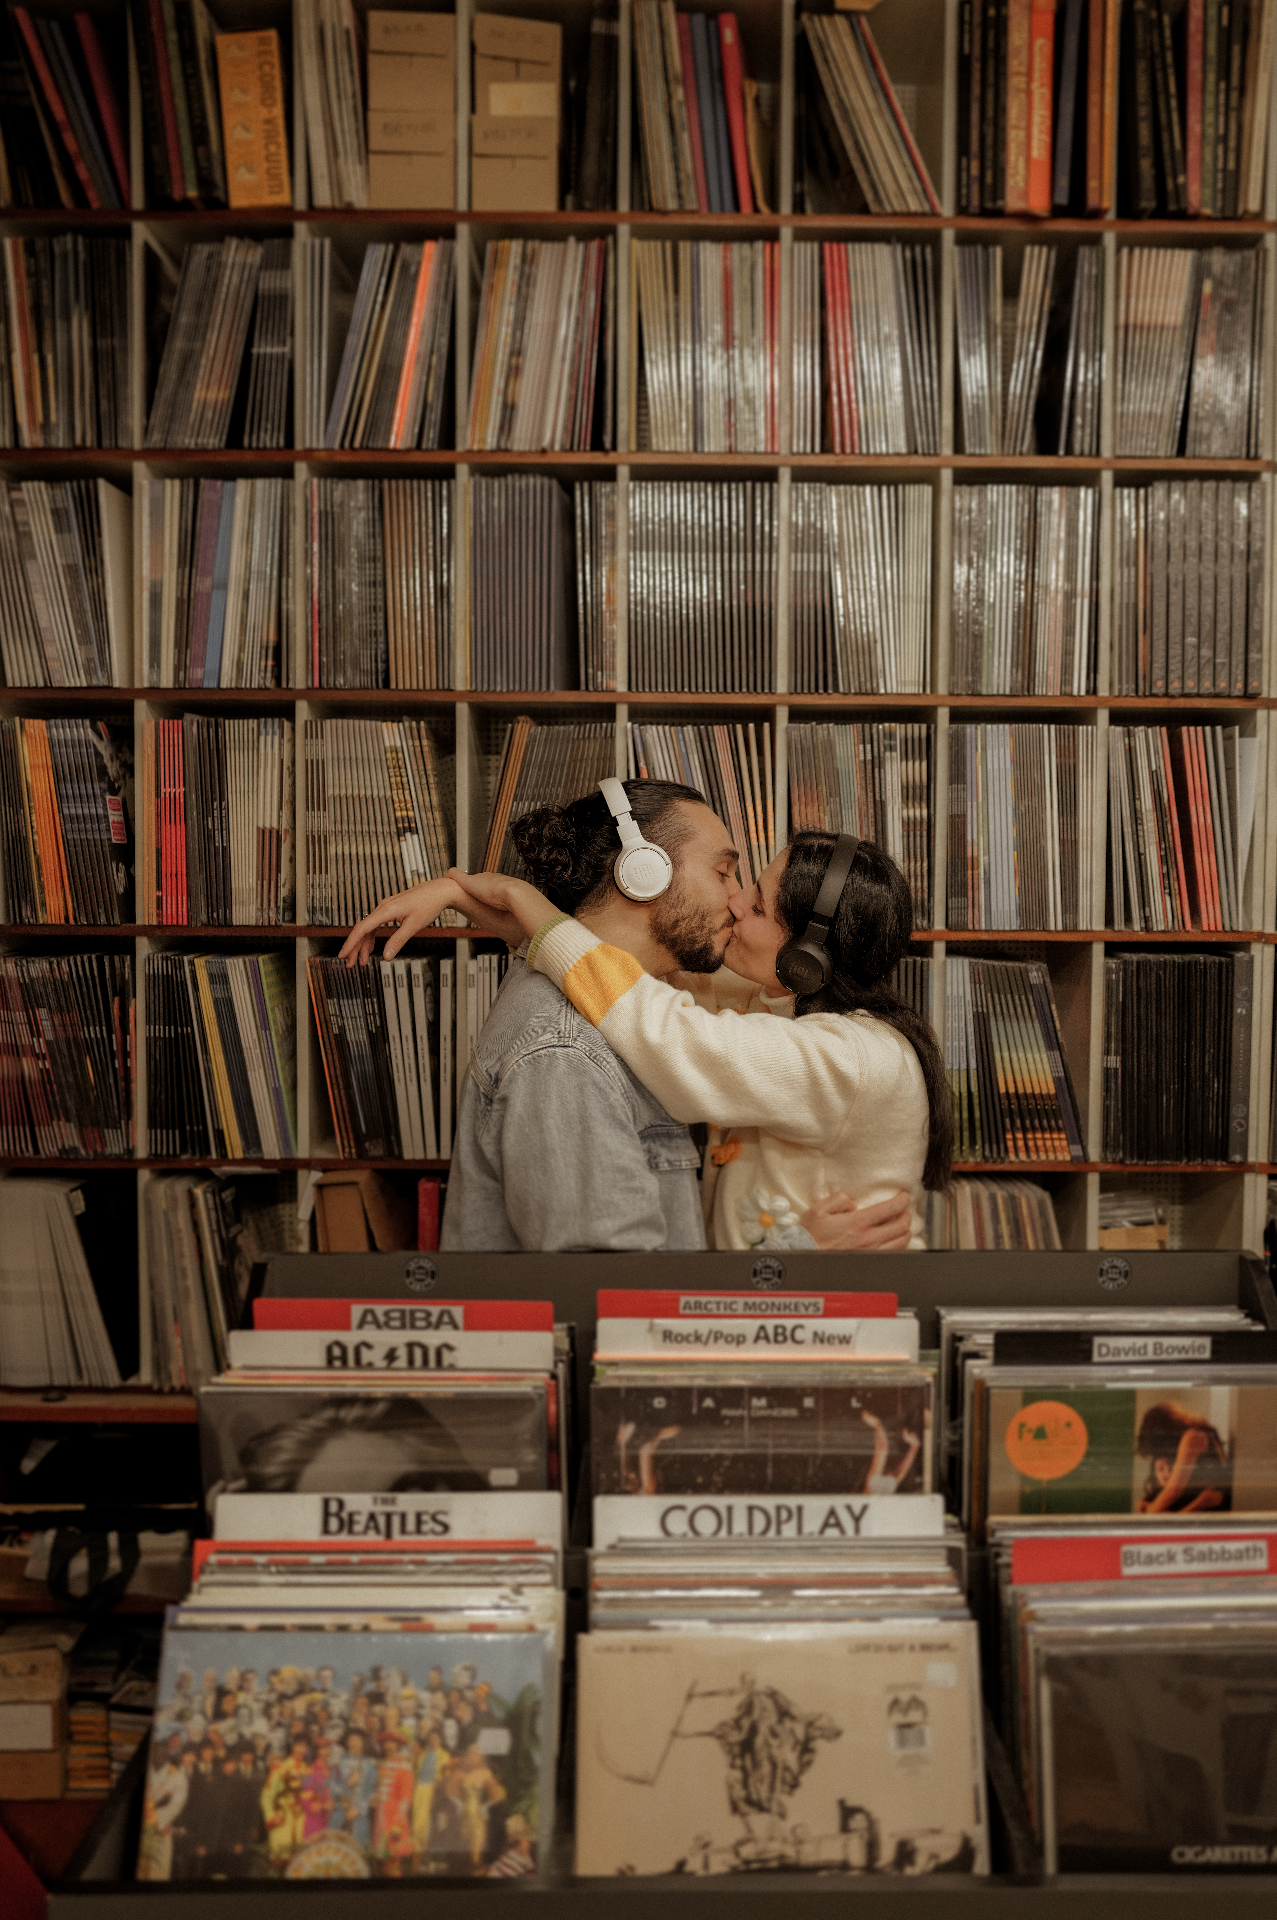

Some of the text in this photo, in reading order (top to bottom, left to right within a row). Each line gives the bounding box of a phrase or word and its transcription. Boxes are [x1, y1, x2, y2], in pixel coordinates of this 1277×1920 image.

[681, 1300, 821, 1314] ARCTIC MONKEYS
[356, 1308, 460, 1330] ABBA
[662, 1323, 853, 1348] Rock/Pop ABC New
[1097, 1339, 1207, 1358] David Bowie
[372, 1496, 397, 1506] THE
[321, 1496, 451, 1540] BEATLES
[659, 1503, 870, 1538] COLDPLAY
[1122, 1543, 1265, 1568] Black Sabbath
